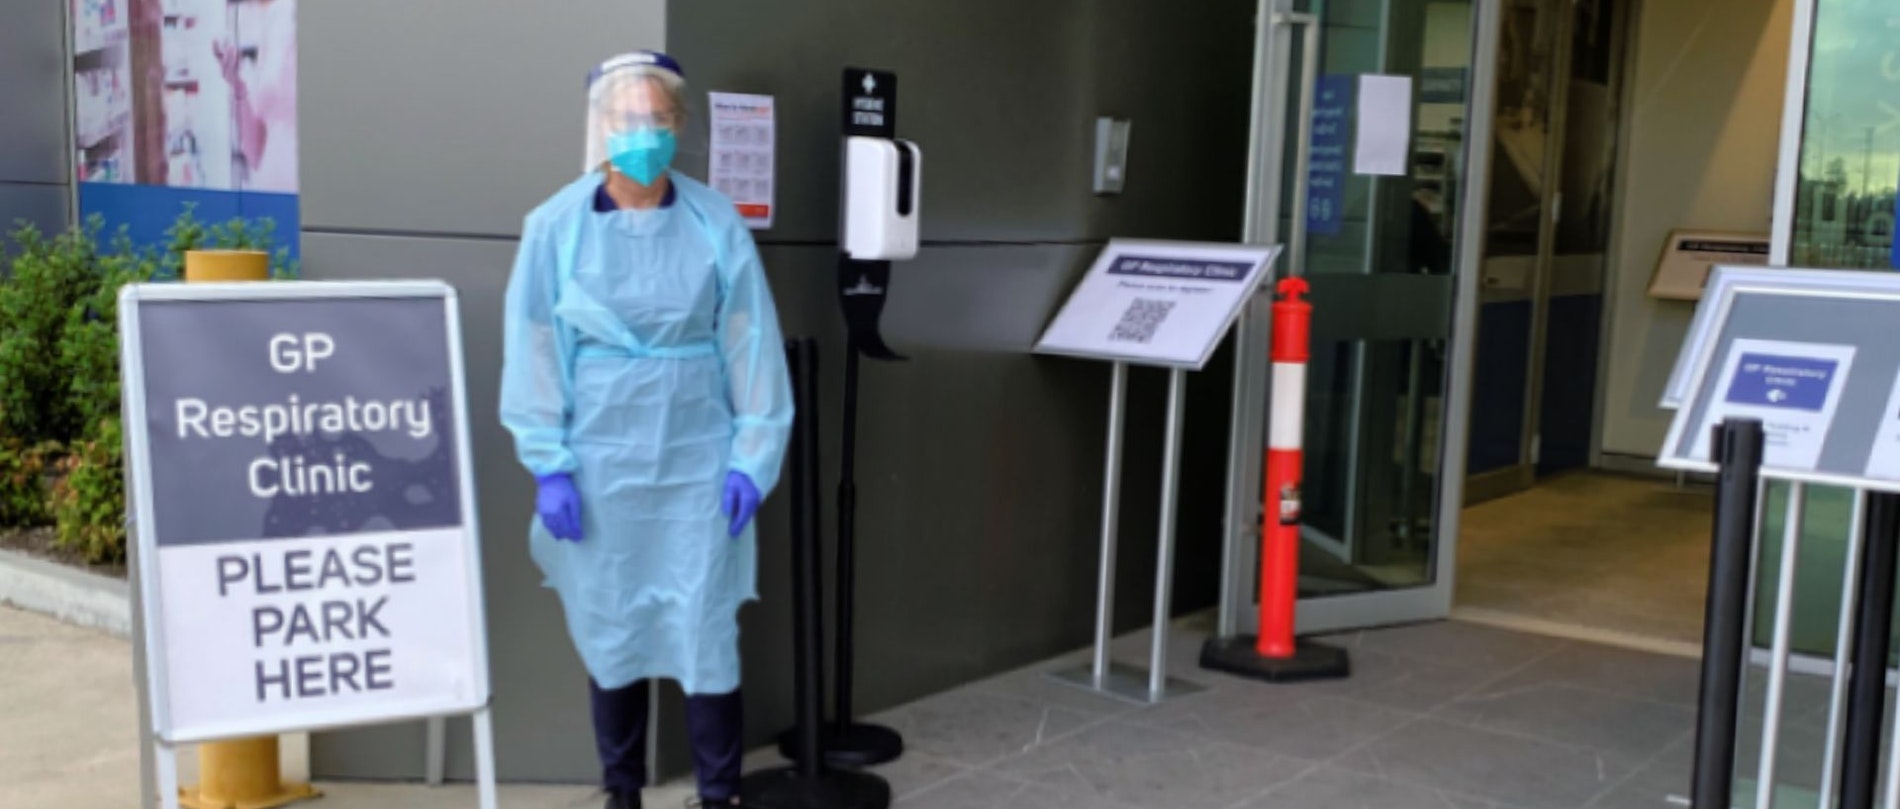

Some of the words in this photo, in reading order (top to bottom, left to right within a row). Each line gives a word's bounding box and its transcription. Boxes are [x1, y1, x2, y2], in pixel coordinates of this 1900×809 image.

[269, 333, 334, 372] GP
[175, 396, 432, 443] Respiratory
[248, 455, 373, 497] Clinic
[216, 543, 416, 597] PLEASE
[252, 597, 391, 648] PARK
[255, 649, 395, 702] HERE
